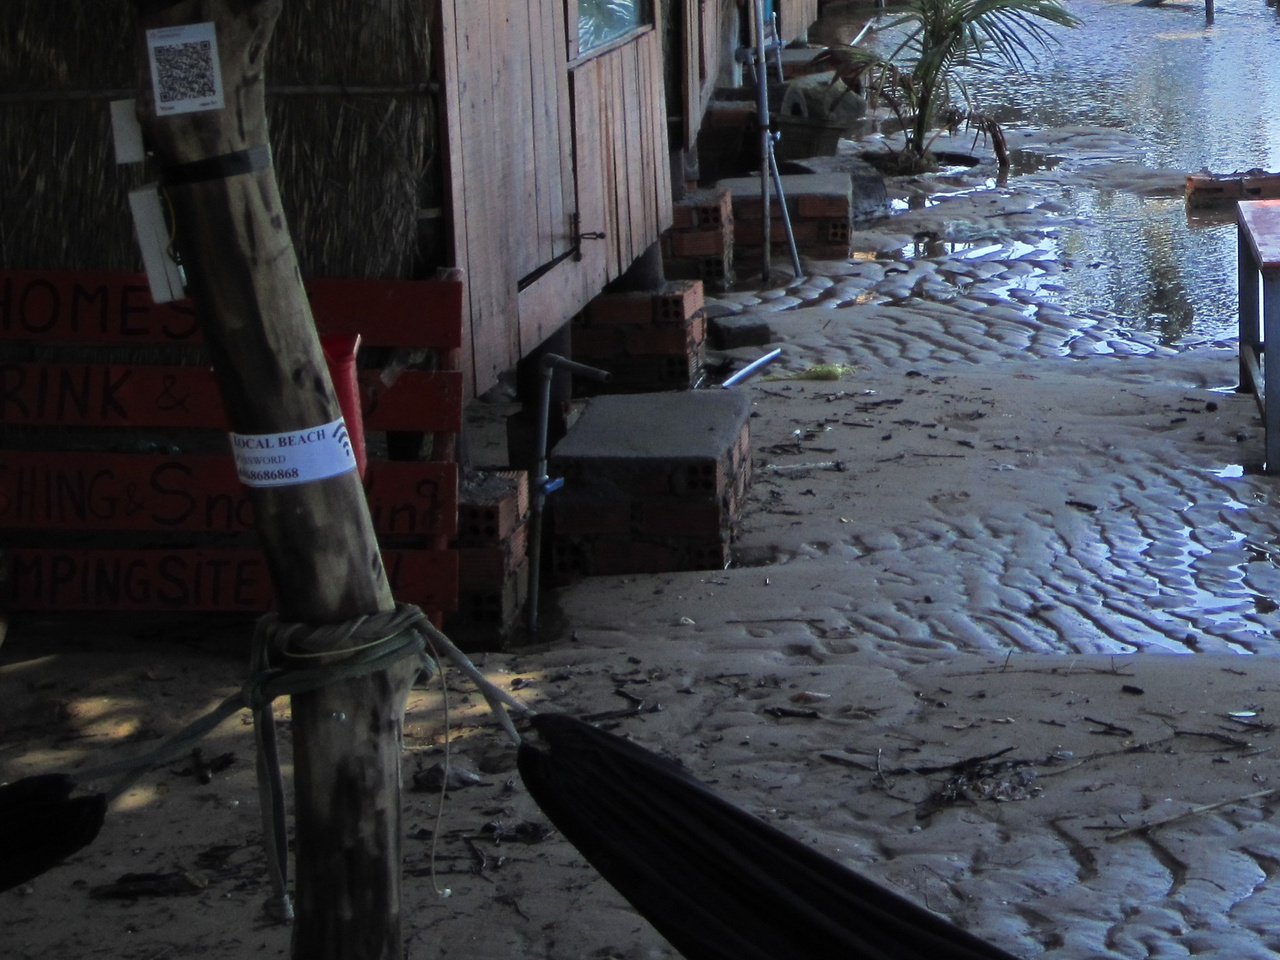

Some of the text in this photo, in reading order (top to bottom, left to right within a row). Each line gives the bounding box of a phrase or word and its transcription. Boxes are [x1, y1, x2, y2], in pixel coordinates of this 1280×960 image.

[156, 374, 191, 414] &
[279, 429, 325, 447] BEACH
[236, 454, 286, 465] SWORD
